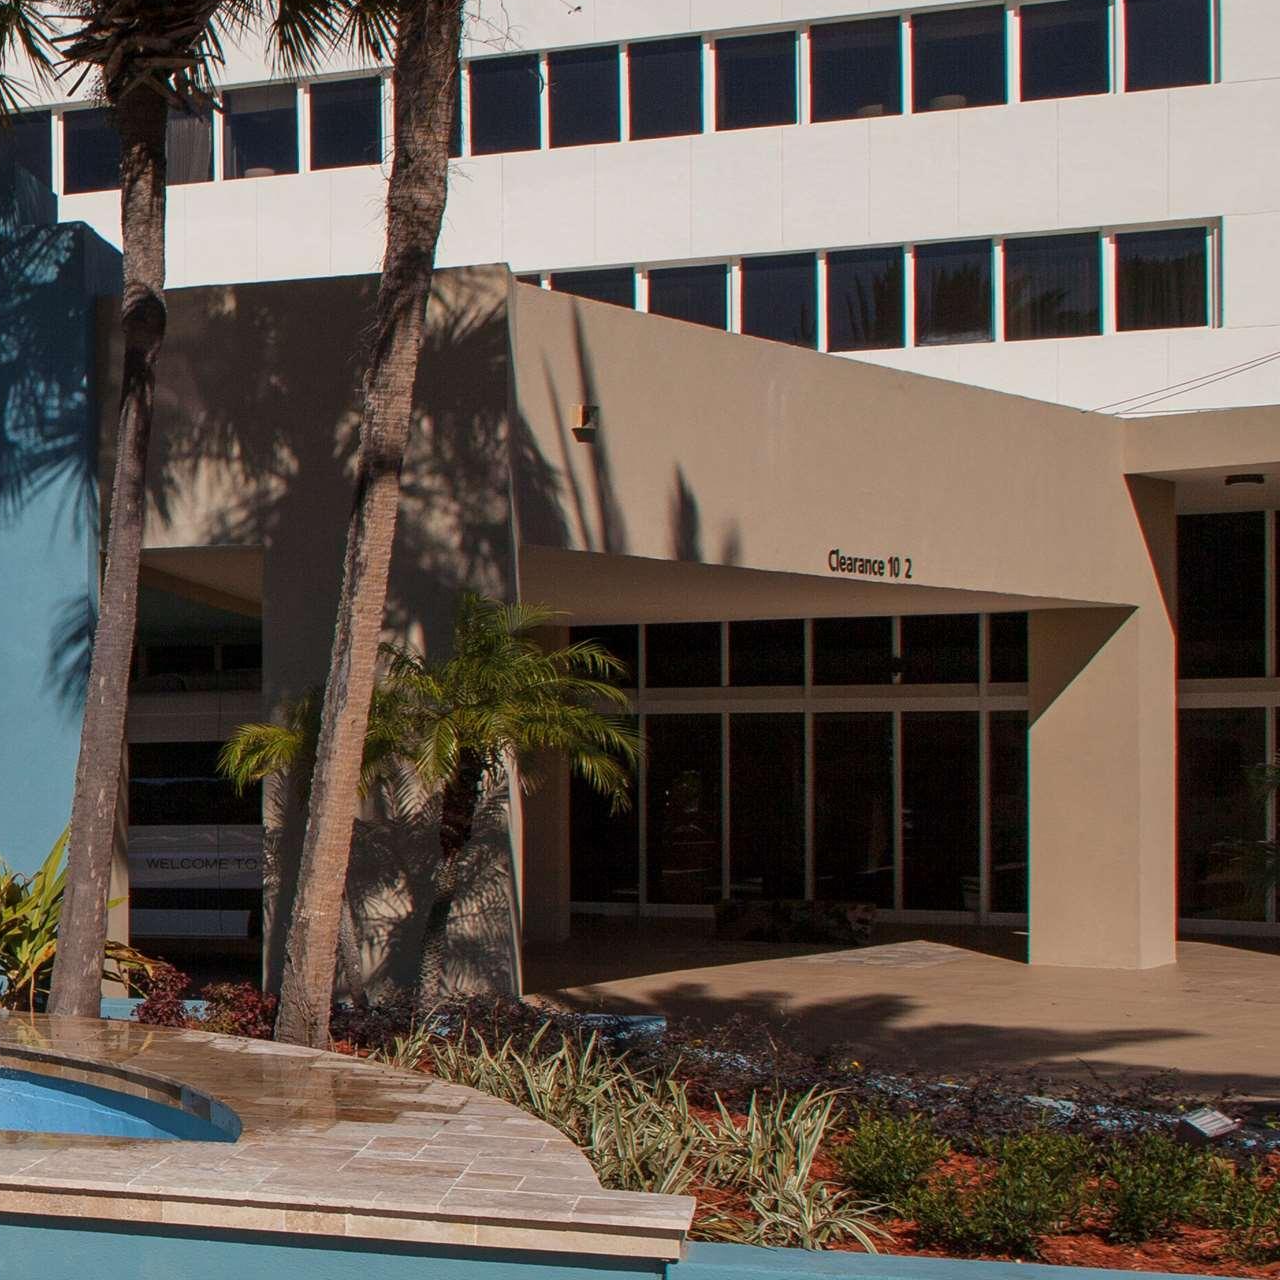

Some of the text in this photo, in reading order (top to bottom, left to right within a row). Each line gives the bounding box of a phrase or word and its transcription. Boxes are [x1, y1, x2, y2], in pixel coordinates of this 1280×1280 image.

[828, 549, 912, 579] Clearance 10 2
[145, 857, 258, 870] WELCOME TO
